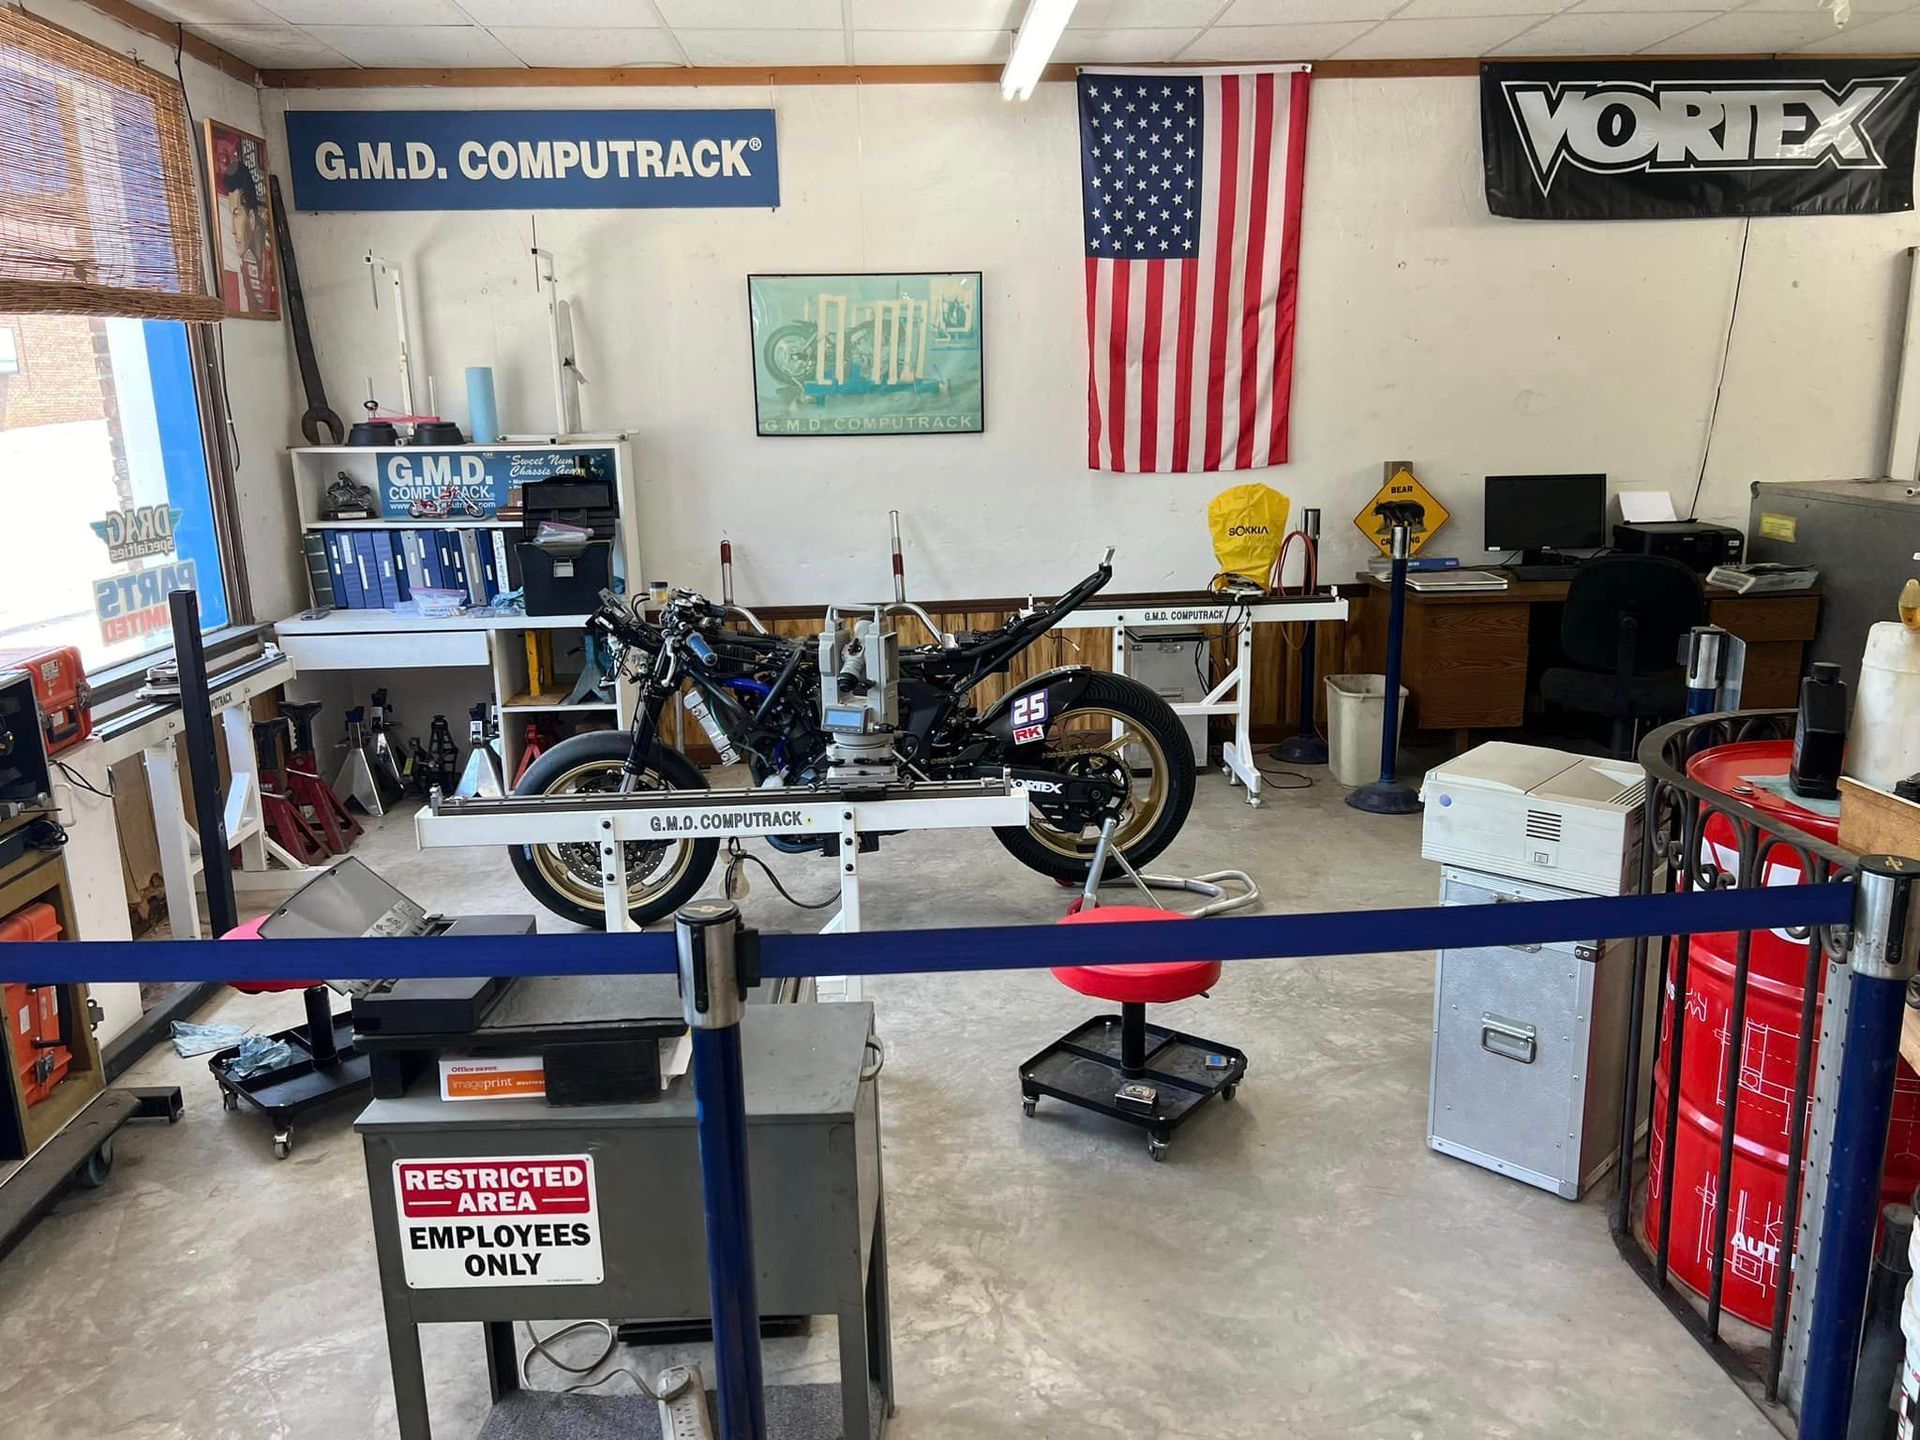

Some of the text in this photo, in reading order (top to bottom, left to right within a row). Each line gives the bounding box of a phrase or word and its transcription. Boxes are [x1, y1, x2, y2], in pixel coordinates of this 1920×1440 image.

[1506, 82, 1892, 186] VORTEX
[315, 141, 447, 180] G.M.D.
[764, 416, 973, 432] G.M.D. COMPUTRACK
[387, 455, 494, 486] G.M.D.
[509, 465, 551, 477] Chassis
[1391, 485, 1413, 494] BEAR
[1229, 525, 1269, 537] SOKKIA
[1380, 536, 1420, 546] CRNG
[1145, 610, 1224, 622] G.M.D. COMPUTRACK
[1013, 691, 1045, 726] 25
[1015, 726, 1039, 742] RK
[650, 811, 803, 832] G.M.D. COMPUTRACK
[404, 1166, 583, 1191] RESTRICTED
[457, 1191, 537, 1213] AREA
[409, 1223, 591, 1250] EMPLOYEES
[464, 1253, 542, 1276] ONLY
